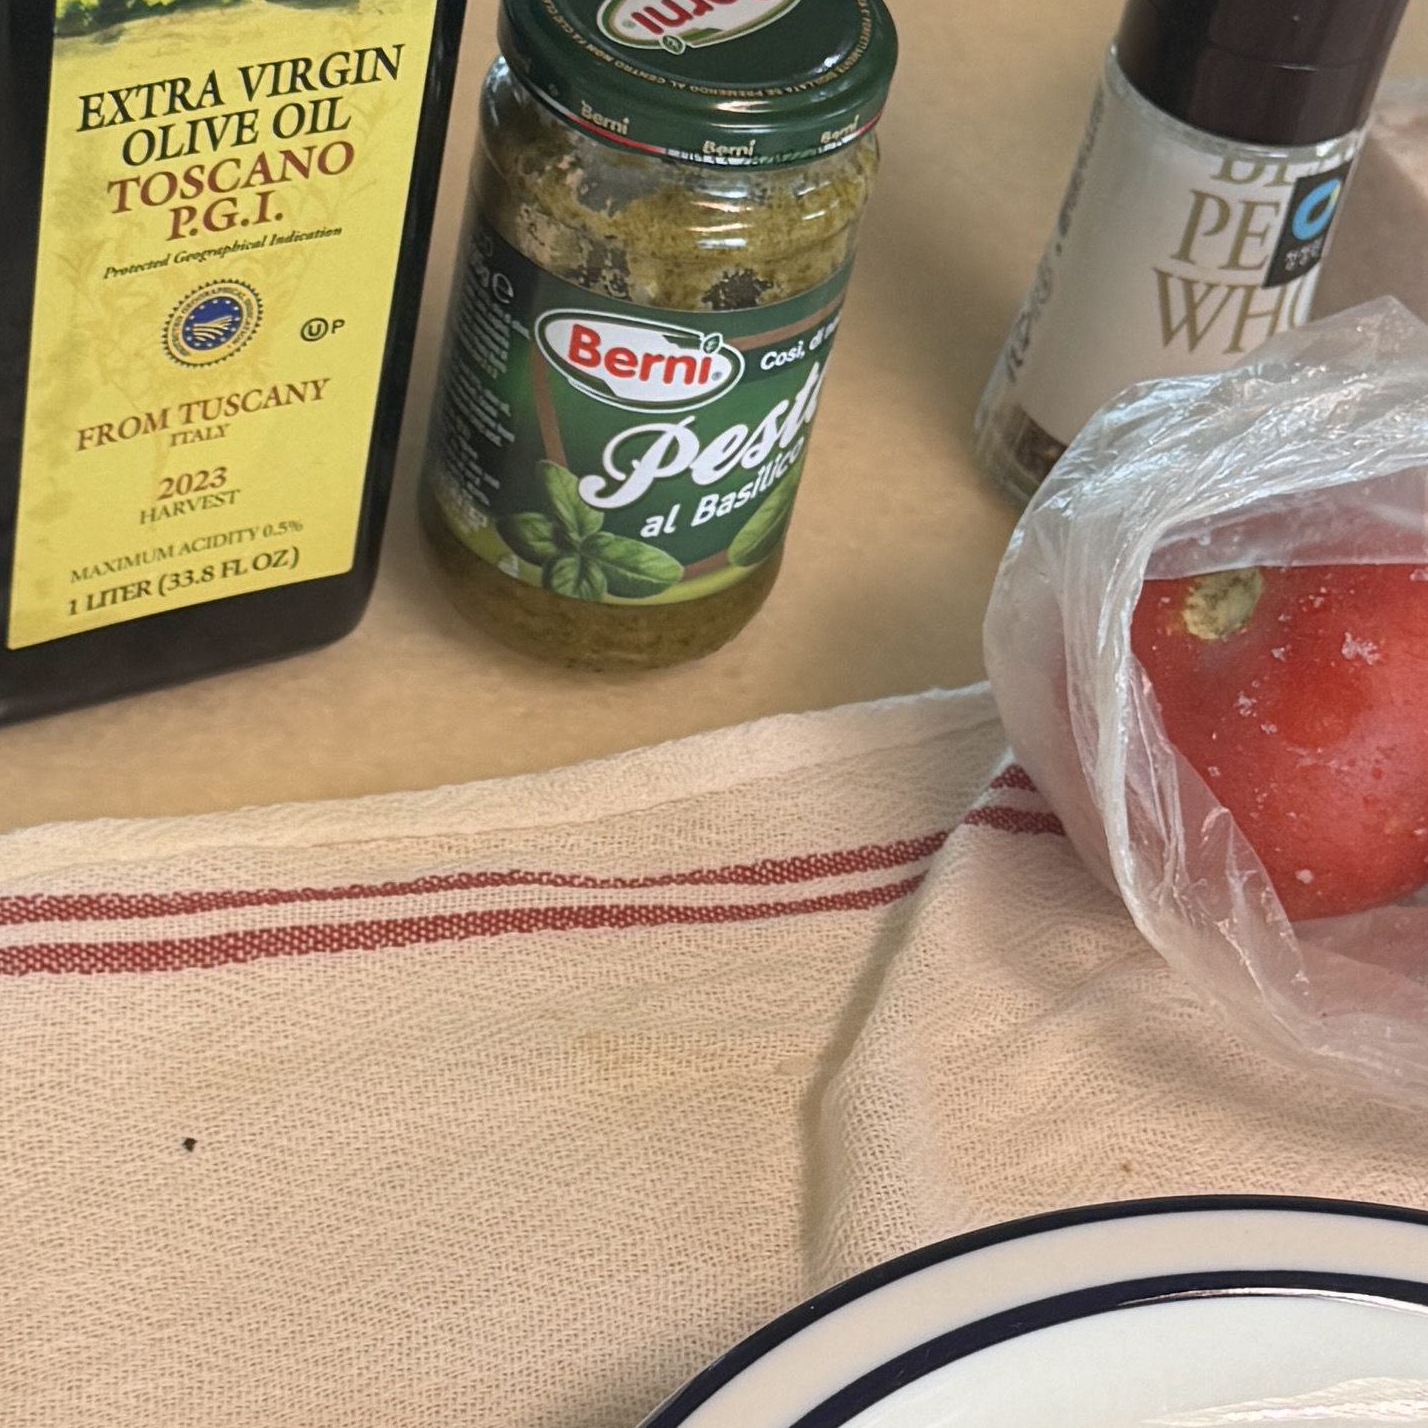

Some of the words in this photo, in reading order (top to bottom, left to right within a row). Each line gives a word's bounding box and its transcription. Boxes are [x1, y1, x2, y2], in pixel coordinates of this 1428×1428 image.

[76, 69, 225, 133] EXTRA
[237, 43, 406, 103] VIRGIN
[613, 60, 666, 85] CENTRO
[669, 80, 686, 90] AL
[121, 110, 260, 167] OLIVE
[272, 95, 352, 138] OIL
[580, 100, 629, 136] Berni
[820, 114, 860, 145] Berni
[702, 139, 756, 158] Berni
[106, 140, 356, 214] TOSCANO
[165, 189, 284, 242] P.G.I.
[103, 253, 171, 280] Protected
[172, 233, 268, 266] Geographical
[270, 225, 343, 247] Indication
[567, 323, 714, 386] Berni
[75, 407, 170, 452] FROM
[178, 377, 331, 427] TUSCANY
[169, 423, 231, 448] ITALY
[139, 489, 242, 525] HARVEST
[157, 466, 228, 501] 2023
[639, 504, 680, 539] al
[690, 436, 805, 528] Basilico
[70, 543, 175, 585] MAXIMUM
[177, 525, 260, 557] ACIDITY
[262, 518, 305, 539] 0.5%
[67, 599, 78, 616] 1
[85, 579, 153, 614] LITER
[158, 564, 215, 600] (33.8
[221, 557, 249, 579] FL
[251, 546, 301, 574] OZ)
